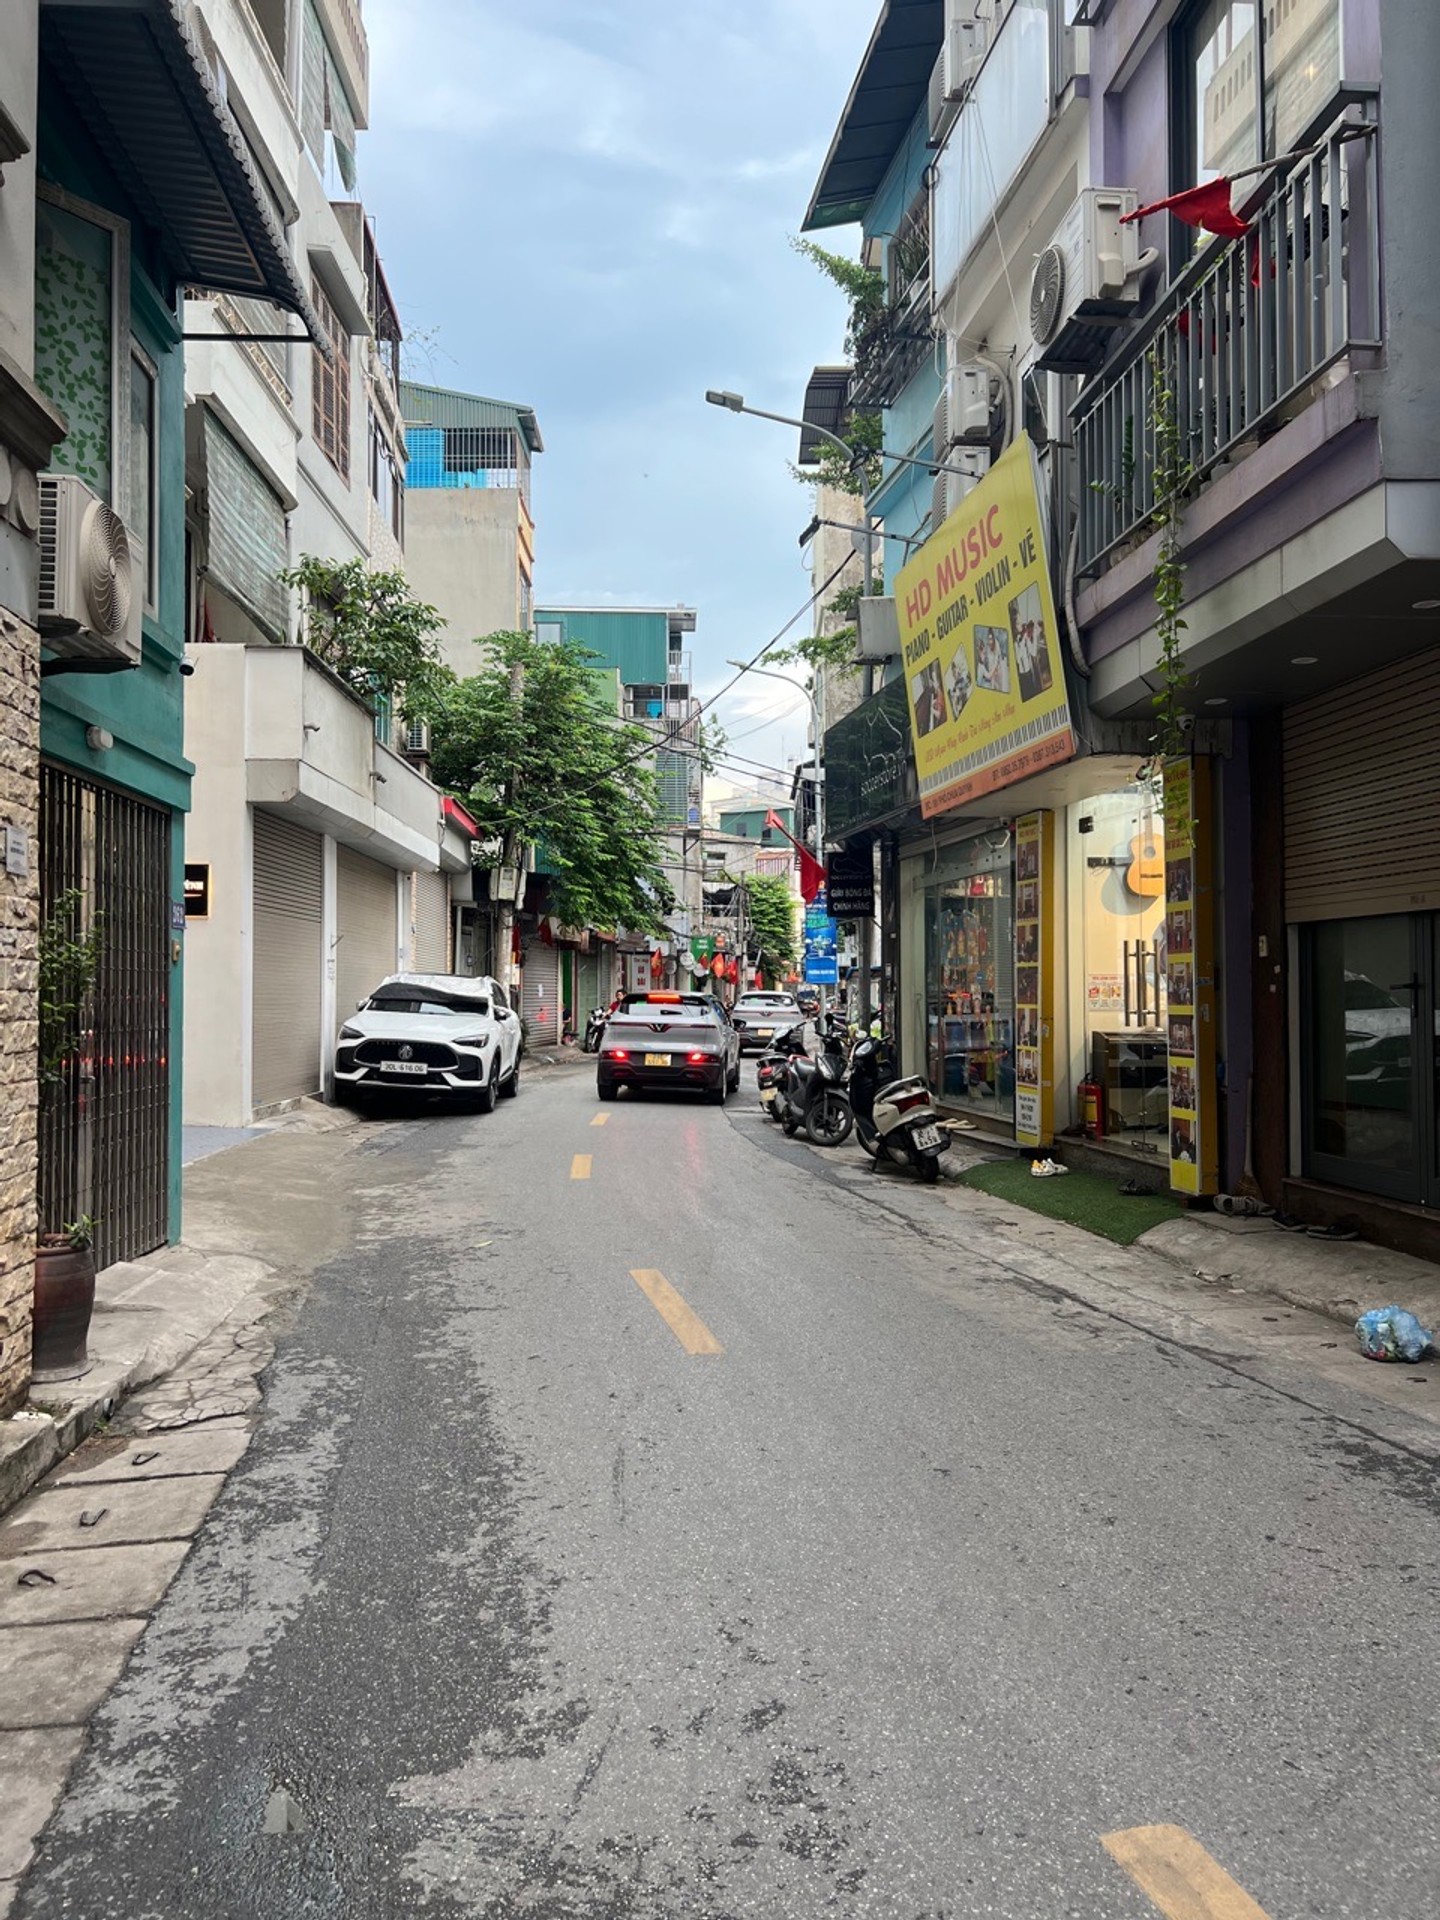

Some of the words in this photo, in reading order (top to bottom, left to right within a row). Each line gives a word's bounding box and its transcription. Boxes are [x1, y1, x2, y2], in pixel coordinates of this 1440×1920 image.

[905, 628, 930, 667] PIANO
[936, 594, 969, 641] GUITAR
[974, 555, 1011, 607] VIOLIN
[906, 579, 932, 629] HD
[936, 504, 1003, 600] MUSIC
